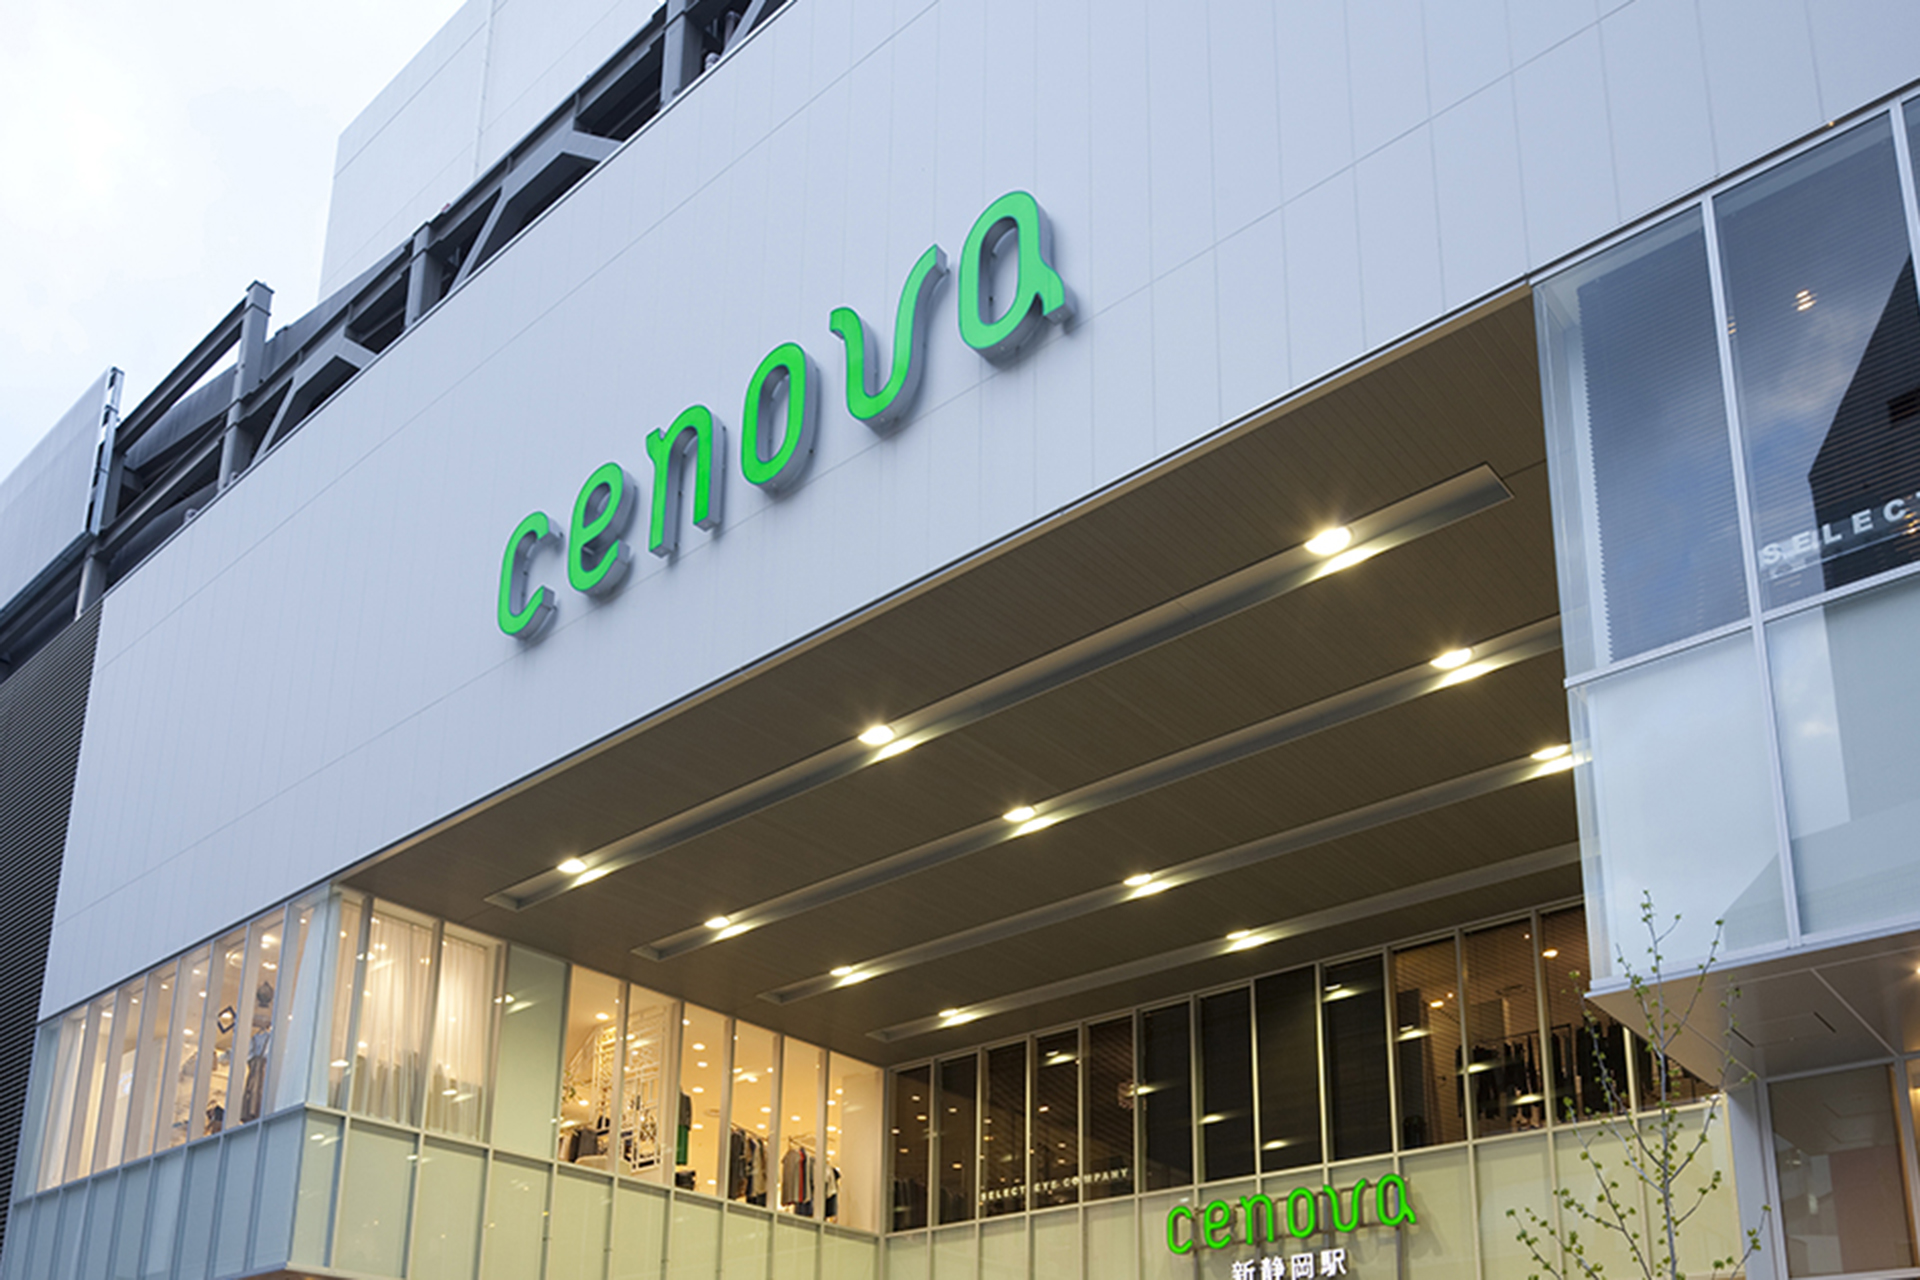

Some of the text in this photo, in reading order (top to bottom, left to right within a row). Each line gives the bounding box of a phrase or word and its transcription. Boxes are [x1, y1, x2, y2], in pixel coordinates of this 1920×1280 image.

[498, 190, 1066, 637] cenova
[1761, 491, 1920, 565] SELEC
[981, 1185, 1026, 1202] SELECT
[1063, 1167, 1128, 1188] COMPANY
[1167, 1173, 1416, 1254] cenova
[1231, 1248, 1347, 1280] 新静岡駅
